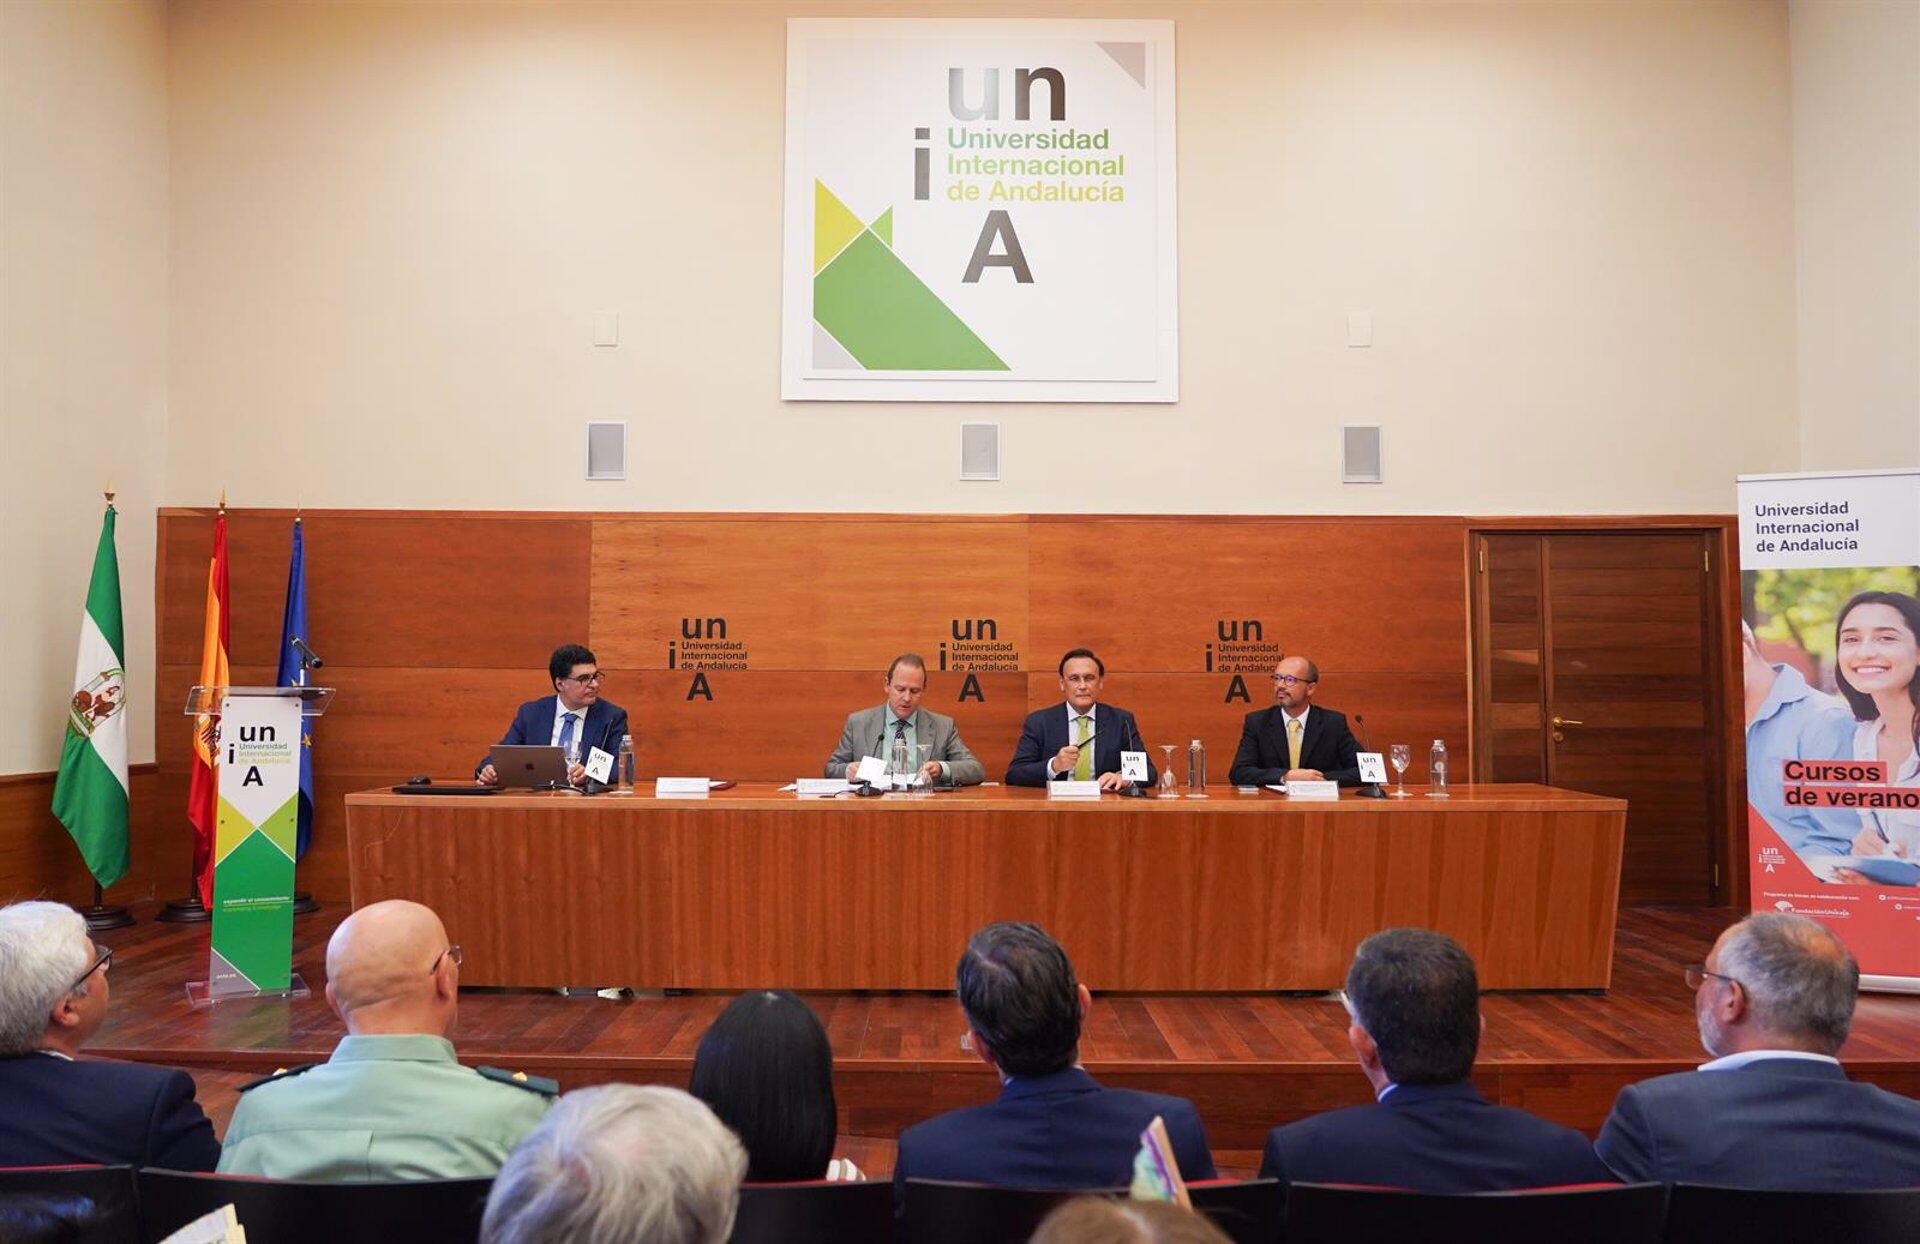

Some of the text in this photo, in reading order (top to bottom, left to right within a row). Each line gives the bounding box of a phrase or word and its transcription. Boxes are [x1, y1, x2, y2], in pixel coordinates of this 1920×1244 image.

[949, 67, 1066, 121] un
[948, 127, 1109, 149] Universidad
[914, 127, 930, 200] i
[948, 154, 1124, 176] Internacional
[948, 180, 1124, 202] de Andalucía
[961, 209, 1035, 284] A
[1755, 501, 1849, 517] Universidad
[1756, 519, 1859, 534] Internacional
[1756, 537, 1858, 552] de Andalucía
[682, 618, 726, 639] un
[952, 619, 997, 640] un
[1218, 620, 1262, 641] un
[682, 641, 742, 650] Universidad
[682, 652, 748, 660] Internacional
[952, 643, 1013, 651] Universidad
[1218, 644, 1279, 652] Universidad
[682, 662, 694, 670] de
[952, 653, 1019, 661] Internacional
[952, 663, 965, 671] de
[1218, 654, 1284, 663] Internacional
[686, 672, 713, 701] A
[958, 673, 985, 702] A
[1224, 674, 1251, 703] A
[240, 726, 275, 742] un
[242, 765, 263, 787] A
[1785, 761, 1880, 781] Cursos
[1785, 787, 1920, 808] de verano
